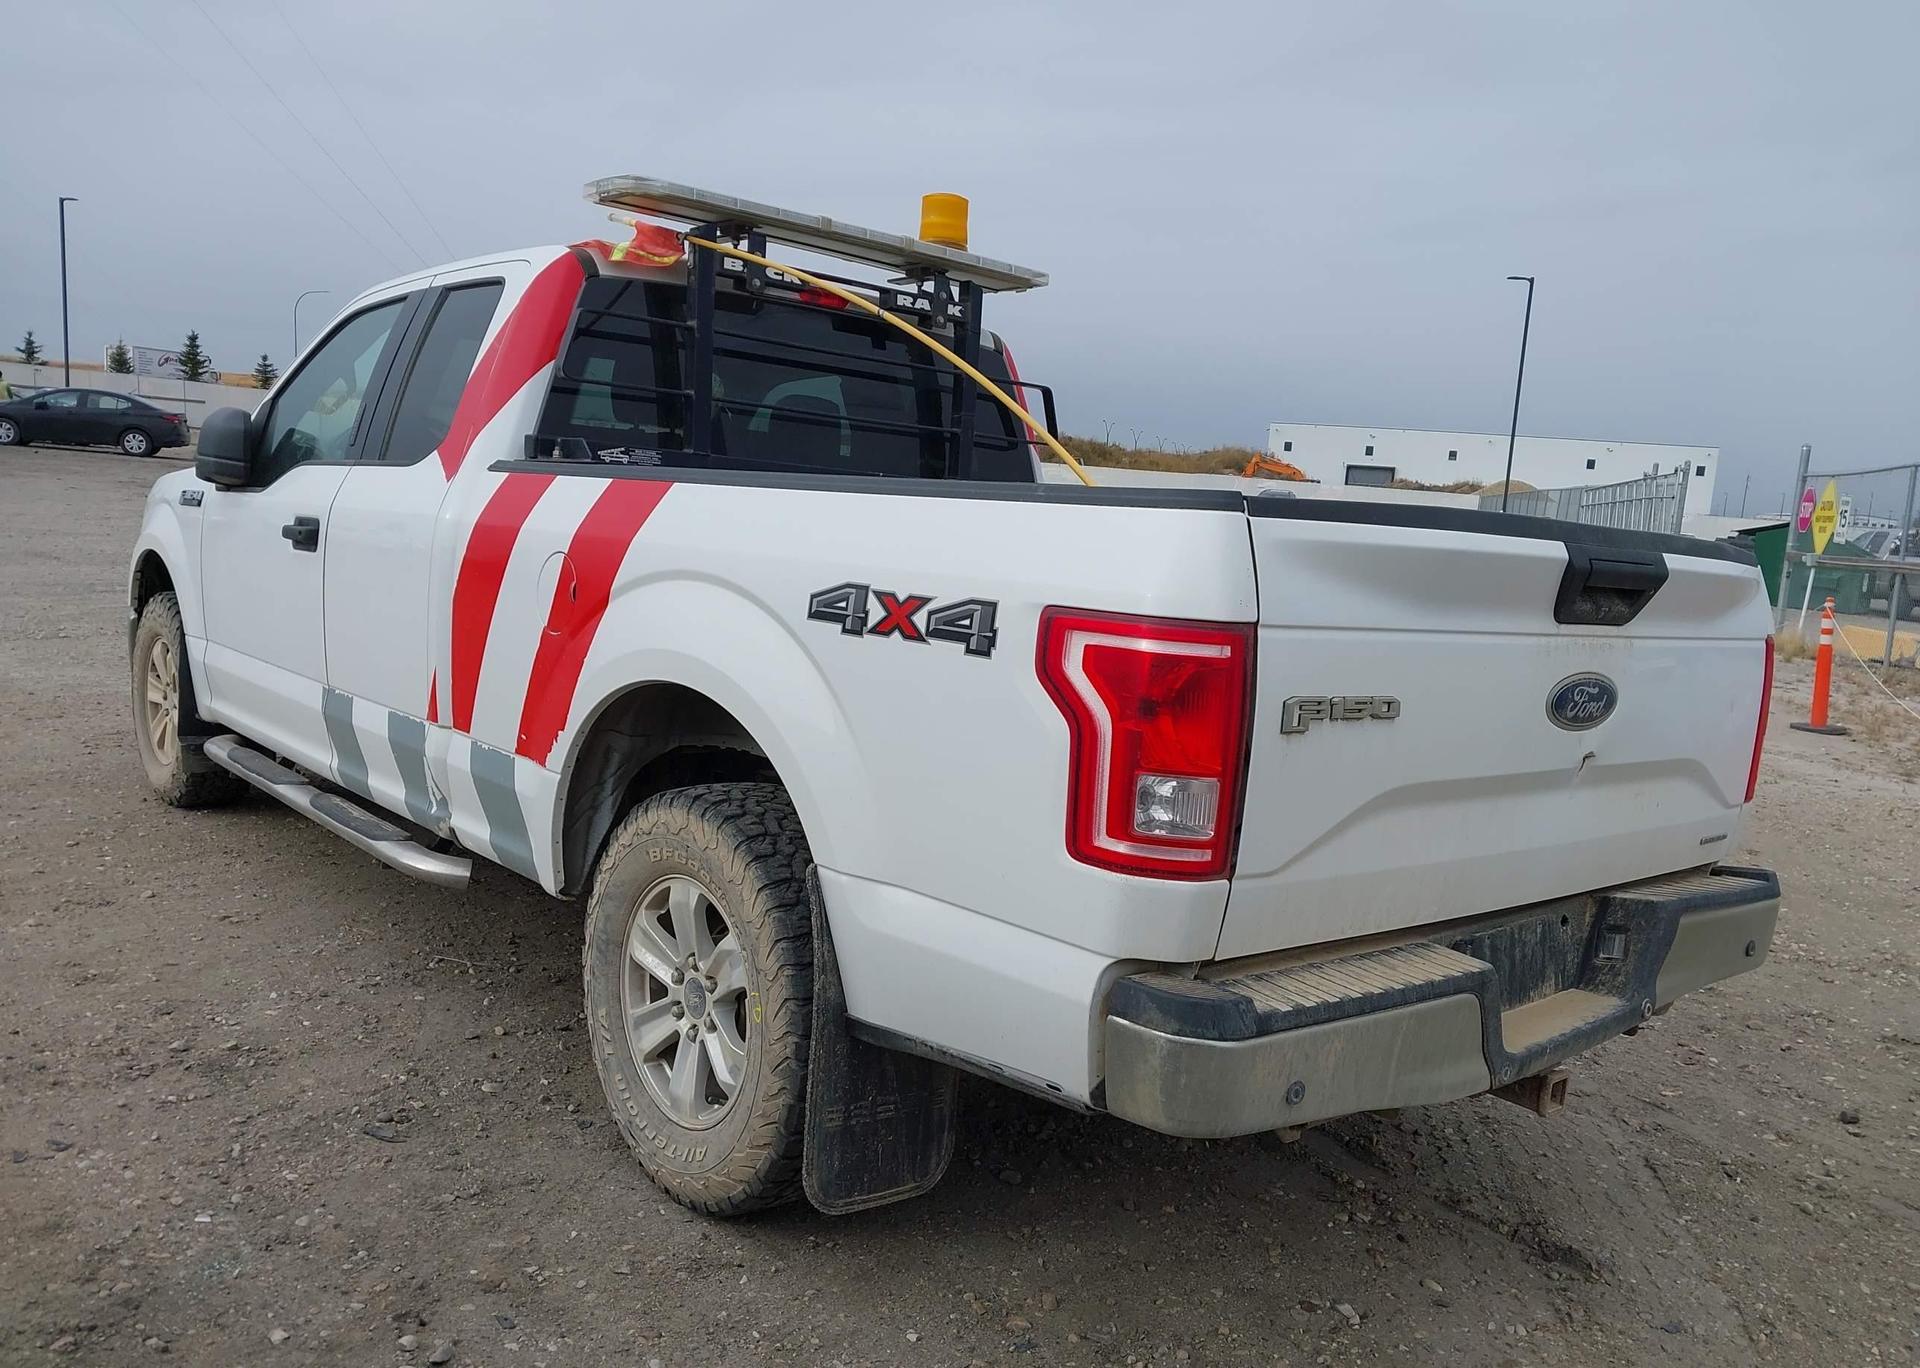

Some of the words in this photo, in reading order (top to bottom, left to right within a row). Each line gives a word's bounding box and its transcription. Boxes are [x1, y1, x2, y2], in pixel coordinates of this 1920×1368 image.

[723, 256, 802, 284] BCK
[896, 294, 964, 318] RAK
[1800, 502, 1814, 518] STOP
[1839, 509, 1848, 528] 15
[1566, 685, 1608, 719] Ford
